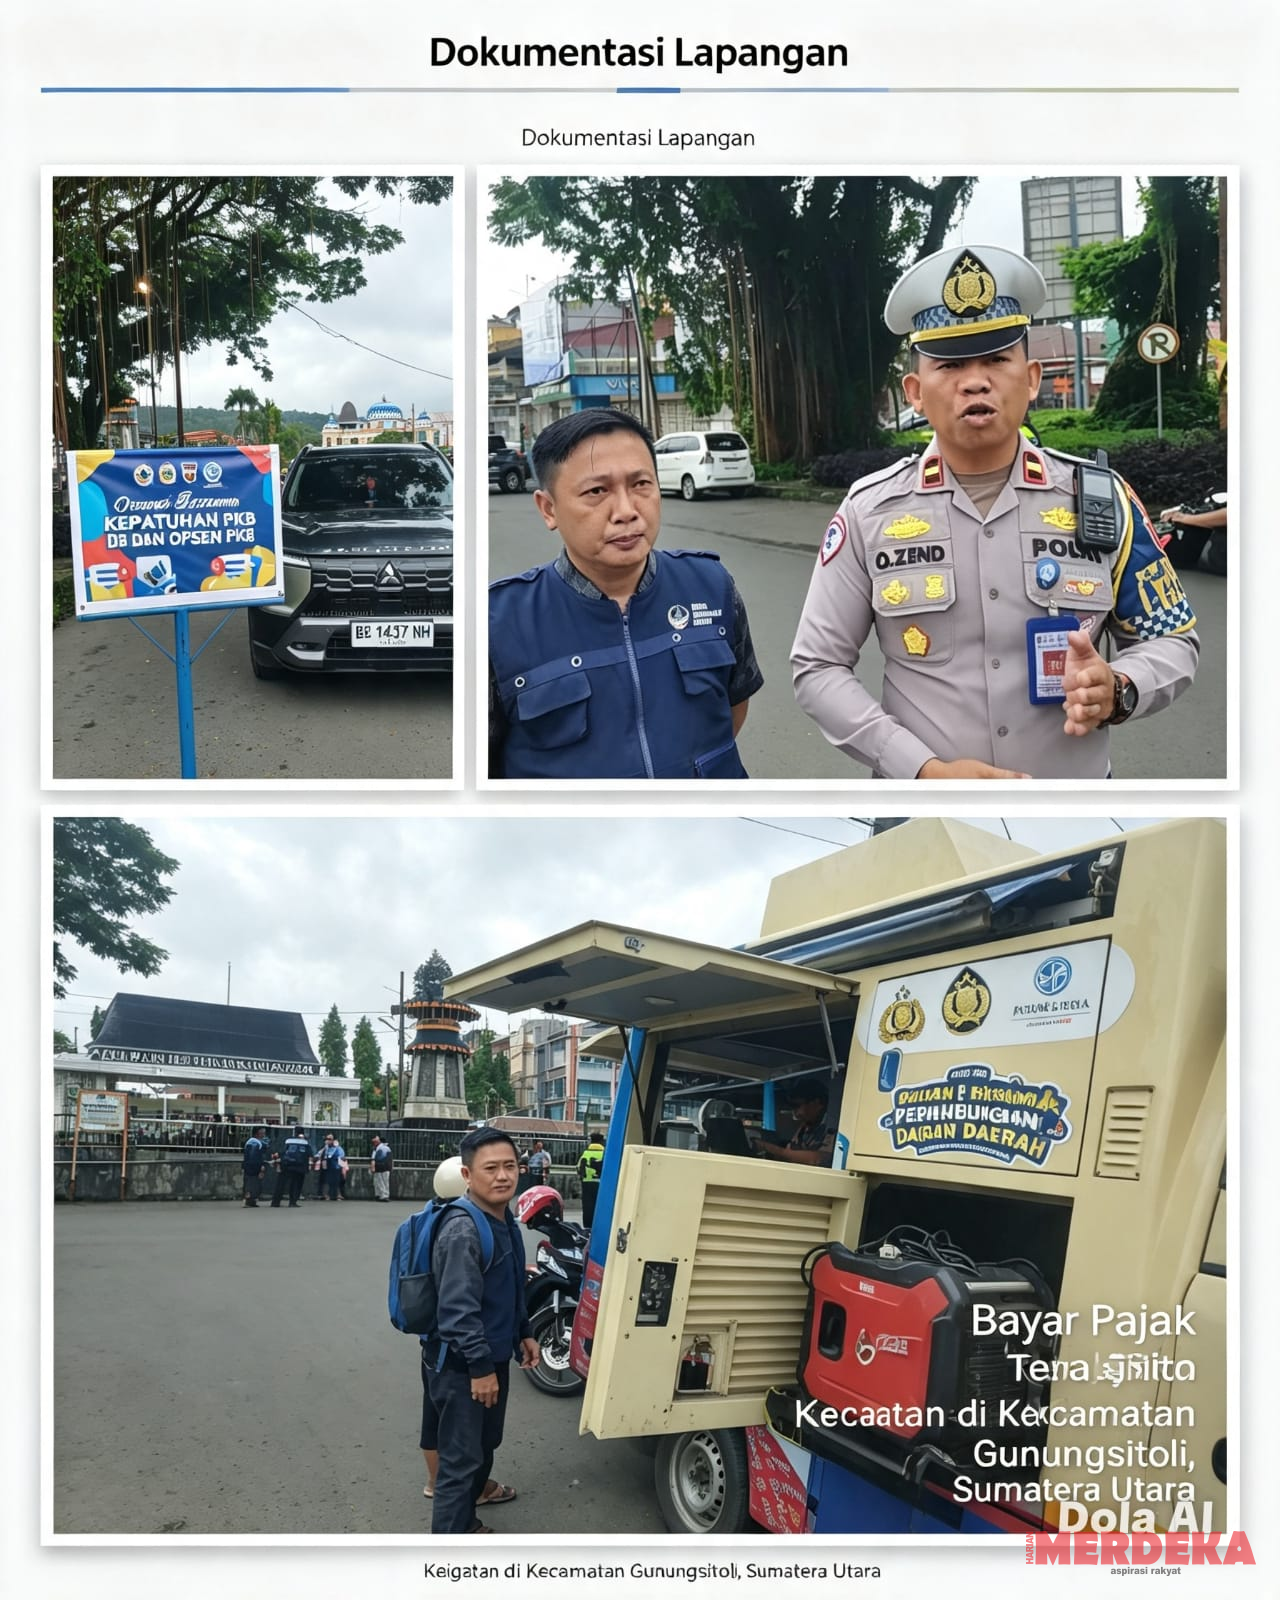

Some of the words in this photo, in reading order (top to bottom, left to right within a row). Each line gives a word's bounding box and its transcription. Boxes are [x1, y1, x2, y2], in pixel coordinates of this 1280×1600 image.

[104, 511, 218, 532] KEPATUHAN
[169, 530, 222, 545] OPSEN
[876, 545, 945, 570] O.ZEND
[413, 625, 430, 639] NH
[963, 1124, 1046, 1160] DAERAH
